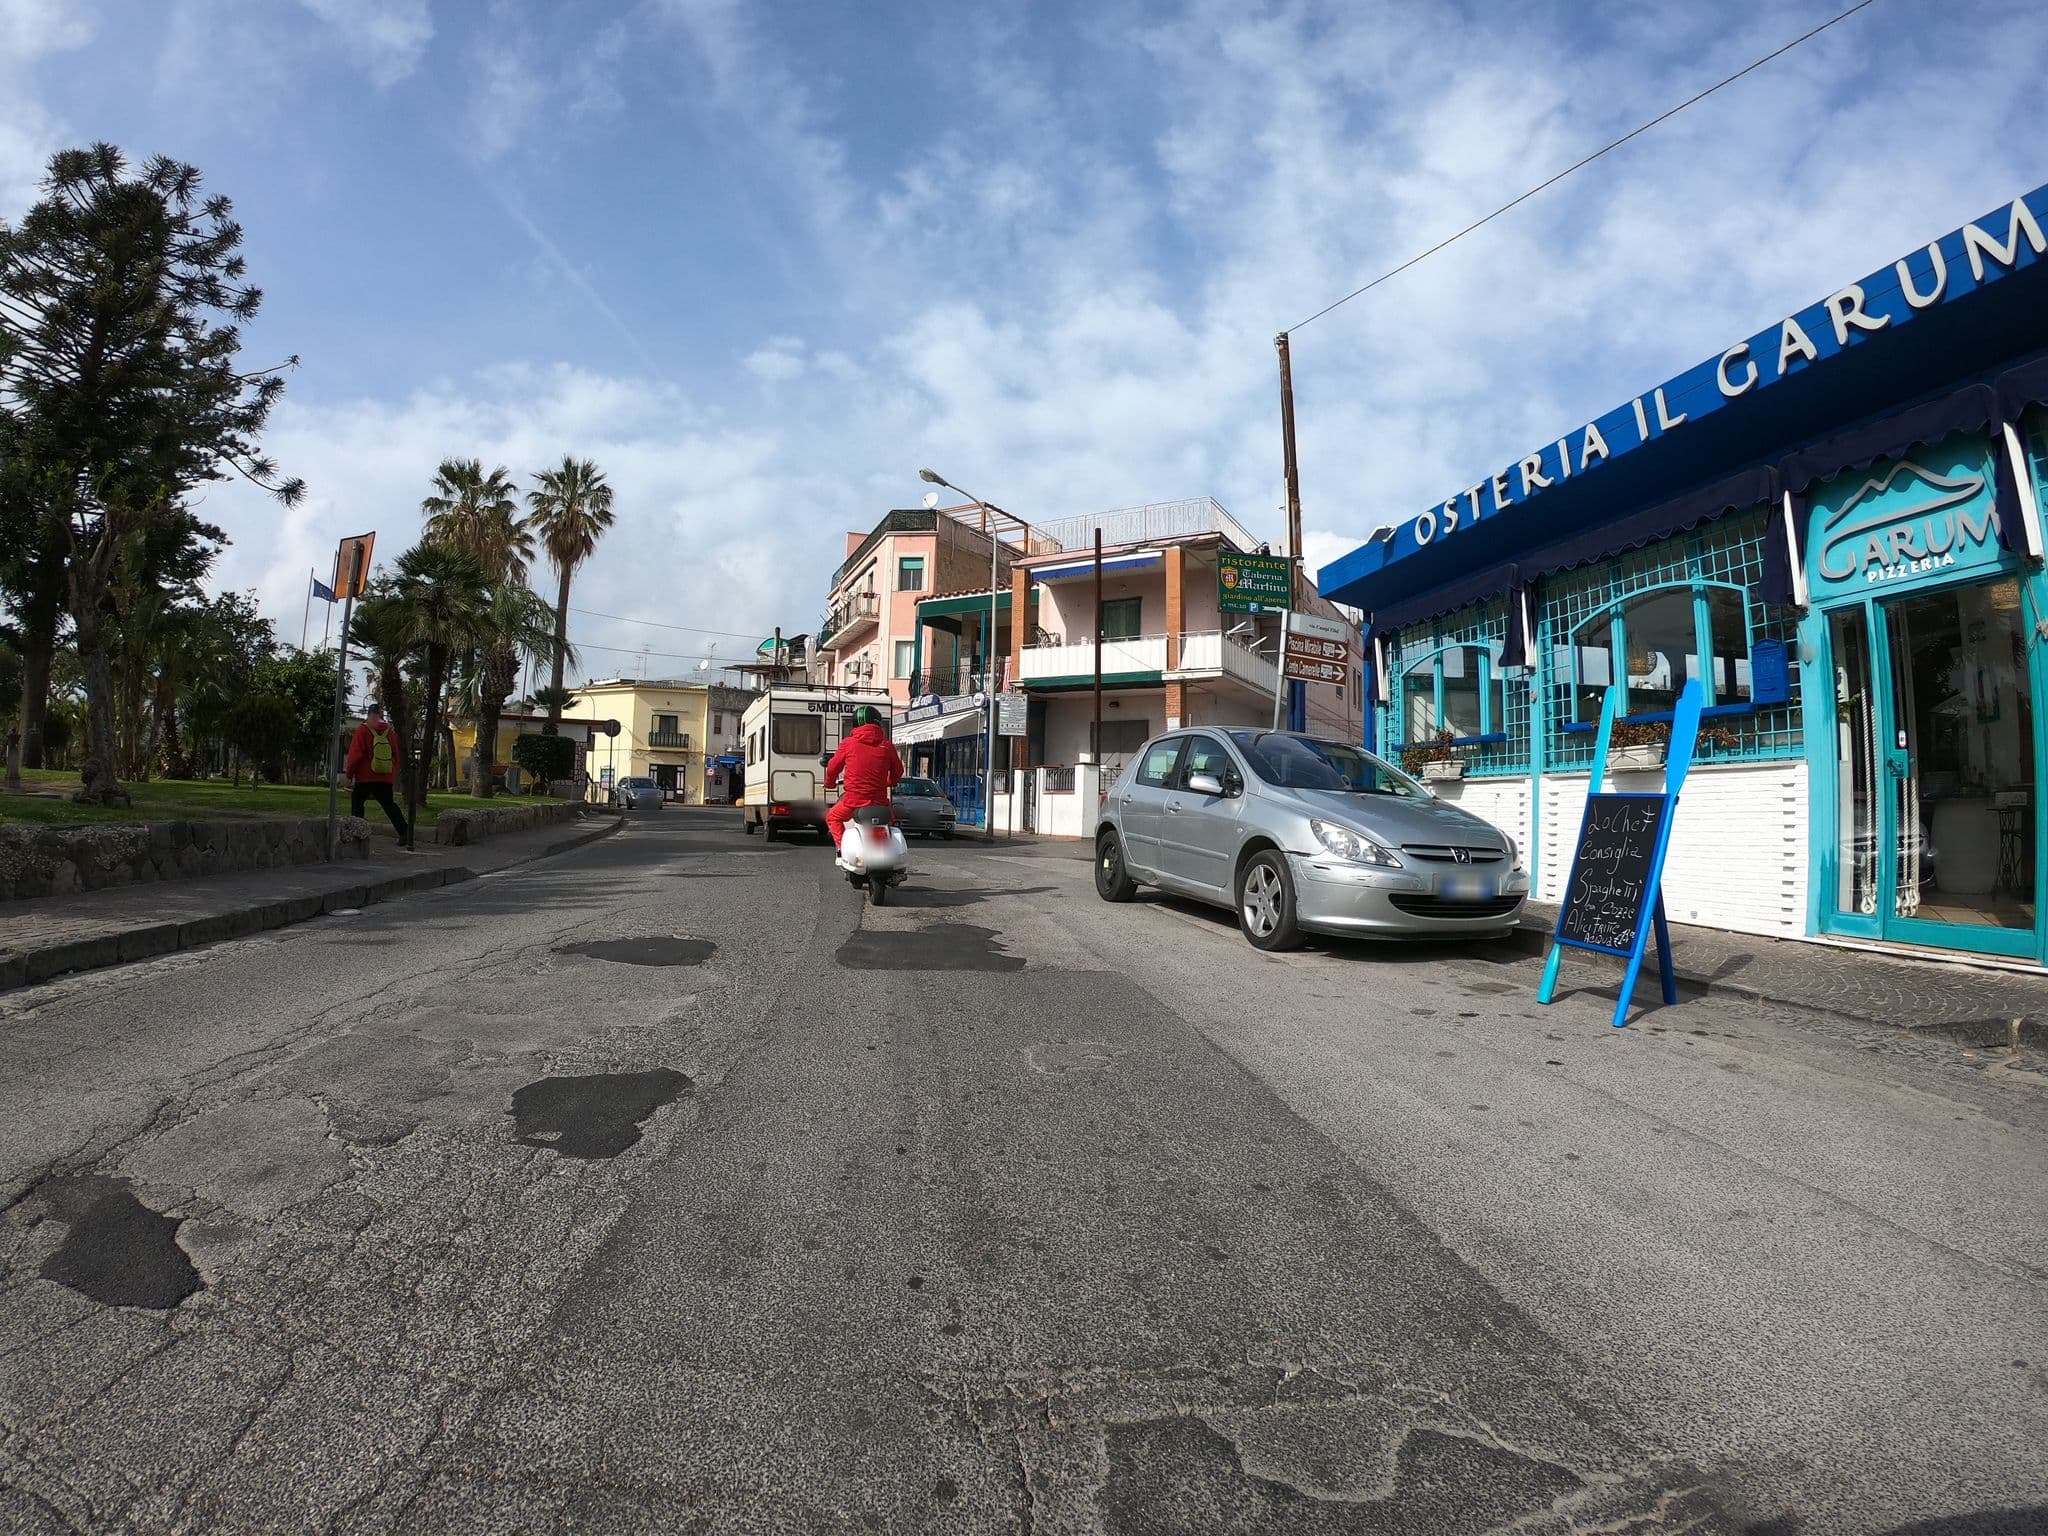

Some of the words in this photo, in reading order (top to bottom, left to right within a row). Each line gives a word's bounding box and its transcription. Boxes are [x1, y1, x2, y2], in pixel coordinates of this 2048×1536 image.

[1414, 422, 1609, 546] OSTERIA
[1632, 387, 1688, 441] IL
[1717, 197, 2048, 398] GARUM
[1819, 501, 2001, 580] GARUM
[1221, 554, 1287, 570] ristorante
[1867, 553, 1955, 583] PIZZERIA
[1235, 578, 1288, 592] Martino
[1241, 568, 1283, 581] Taberna
[1222, 592, 1252, 601] giardino
[1253, 595, 1288, 604] all'aperto
[1288, 636, 1304, 653] Piscina
[815, 702, 856, 714] MIRAGE
[1611, 805, 1656, 833] Chef
[1579, 837, 1643, 874] Consiglia
[1573, 868, 1643, 905] Spaghetti
[1564, 908, 1592, 934] Alici
[1601, 901, 1636, 919] Cozze
